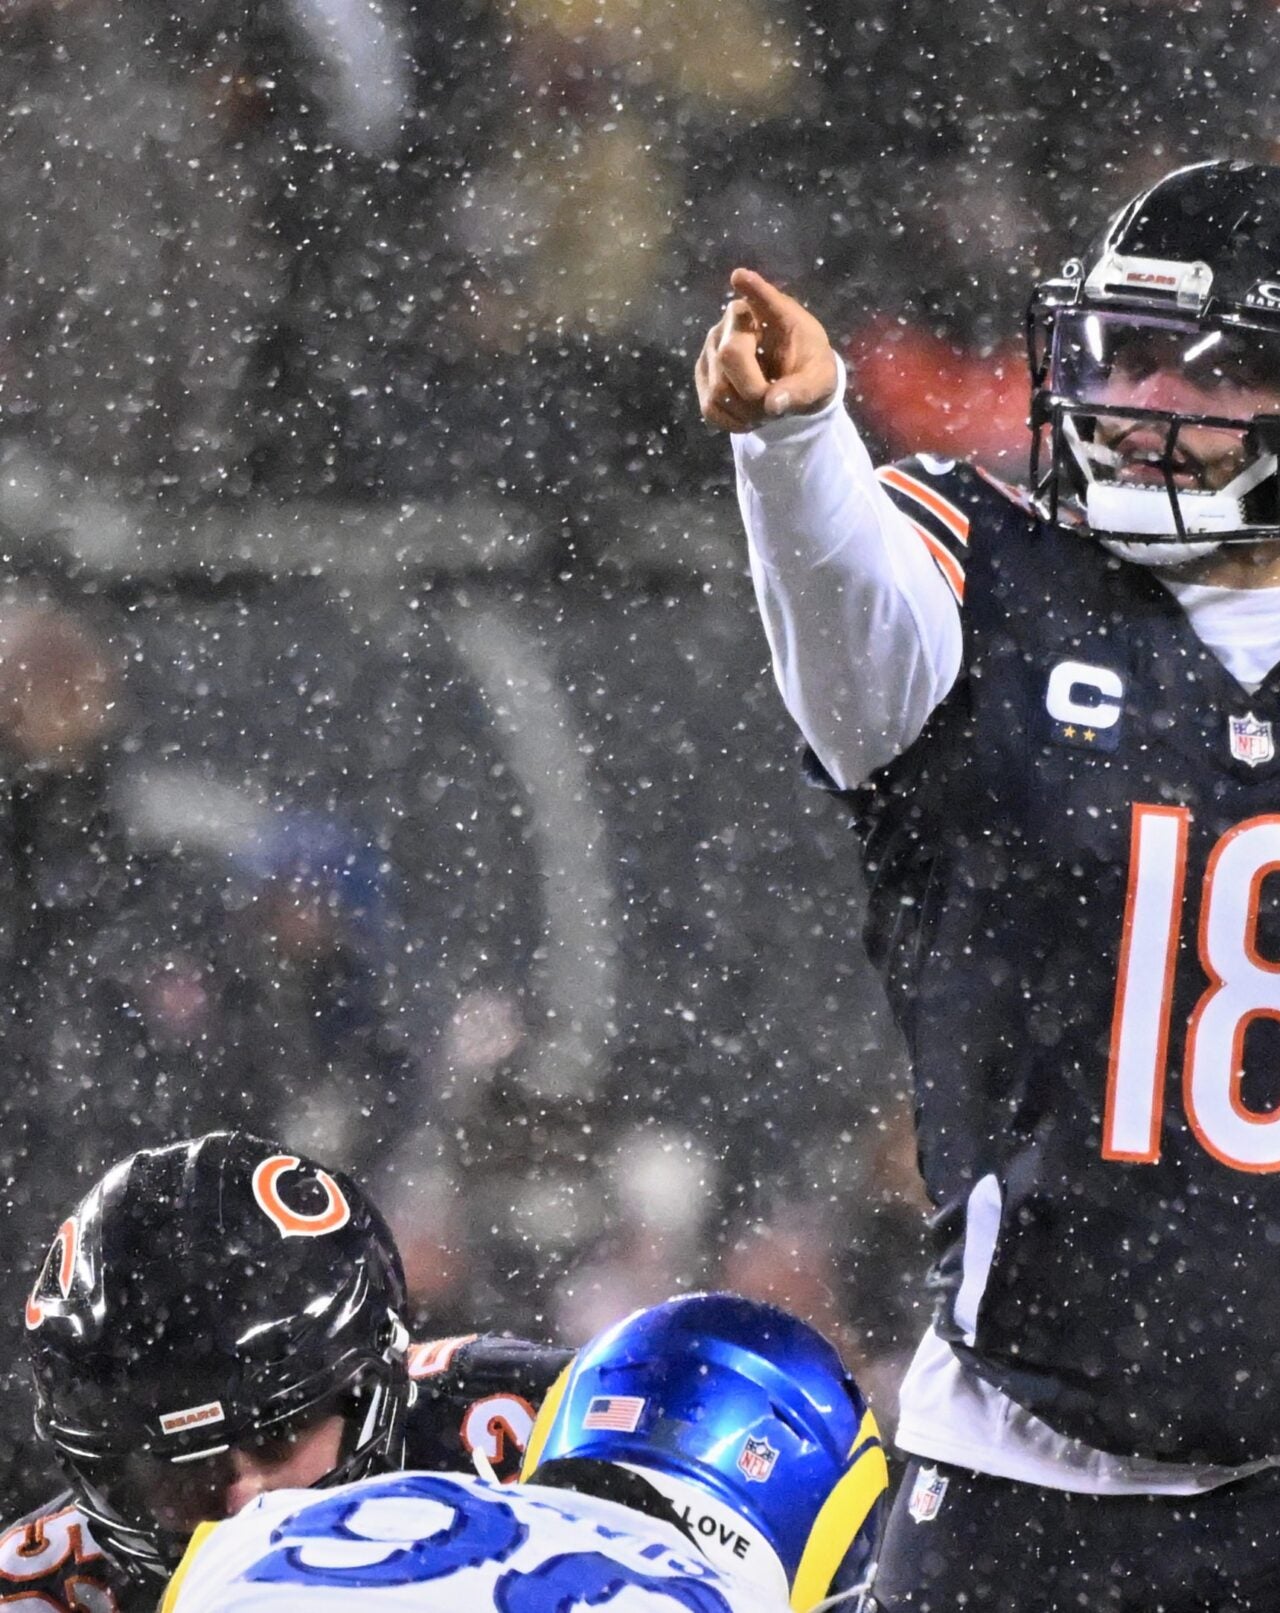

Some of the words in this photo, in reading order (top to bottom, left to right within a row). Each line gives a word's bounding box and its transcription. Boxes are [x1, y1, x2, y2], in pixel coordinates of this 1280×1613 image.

[1046, 661, 1123, 728] C
[164, 1407, 221, 1430] BEARS
[741, 1450, 769, 1479] NFL
[680, 1505, 751, 1560] LOVE
